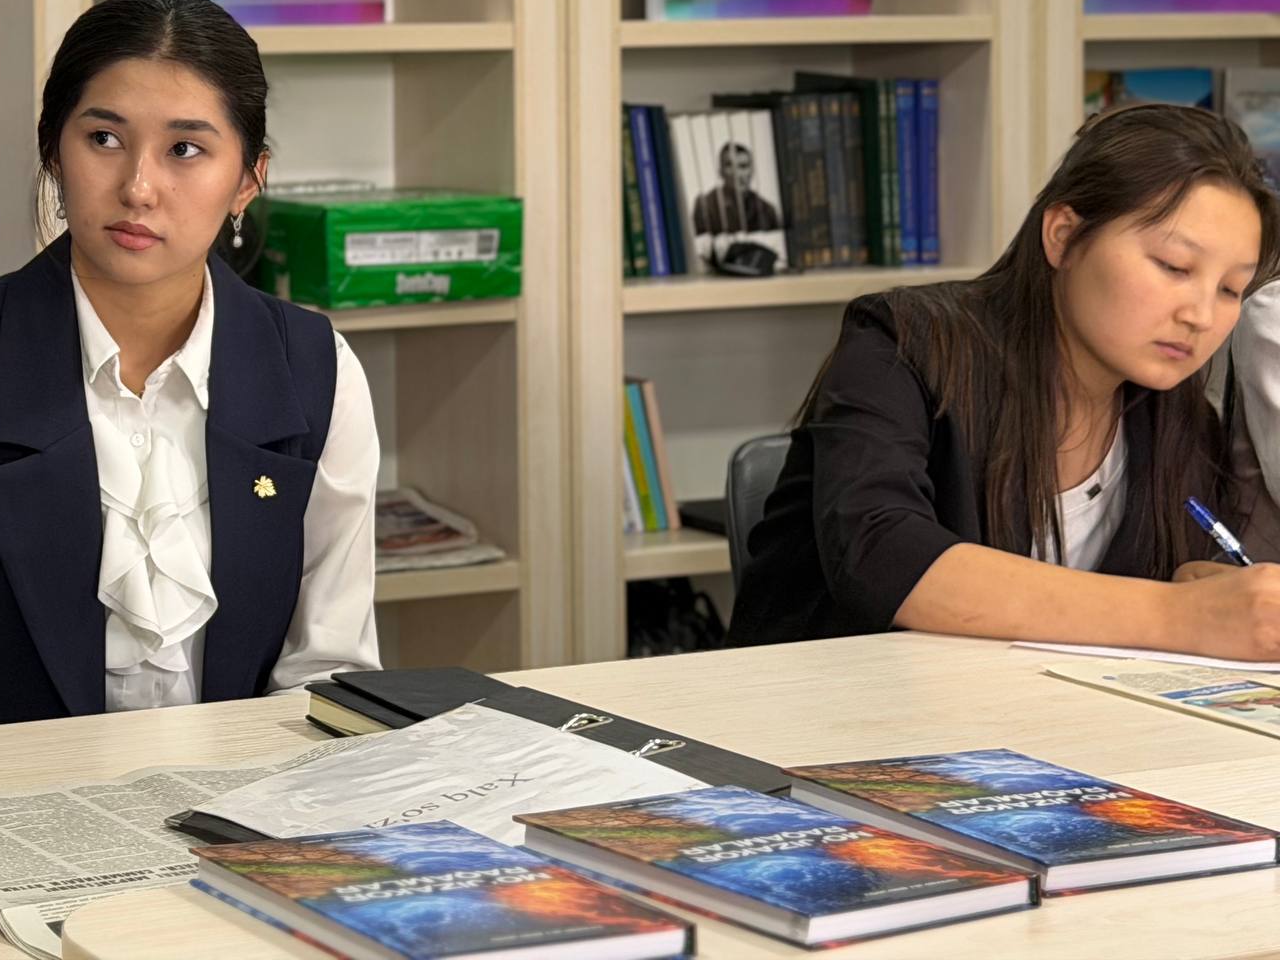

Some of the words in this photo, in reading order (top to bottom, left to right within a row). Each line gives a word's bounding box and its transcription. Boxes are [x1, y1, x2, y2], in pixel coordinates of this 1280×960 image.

[441, 773, 534, 802] Xalq
[935, 786, 1108, 807] RAQAMLAR
[680, 826, 847, 854] RAQAMLAR
